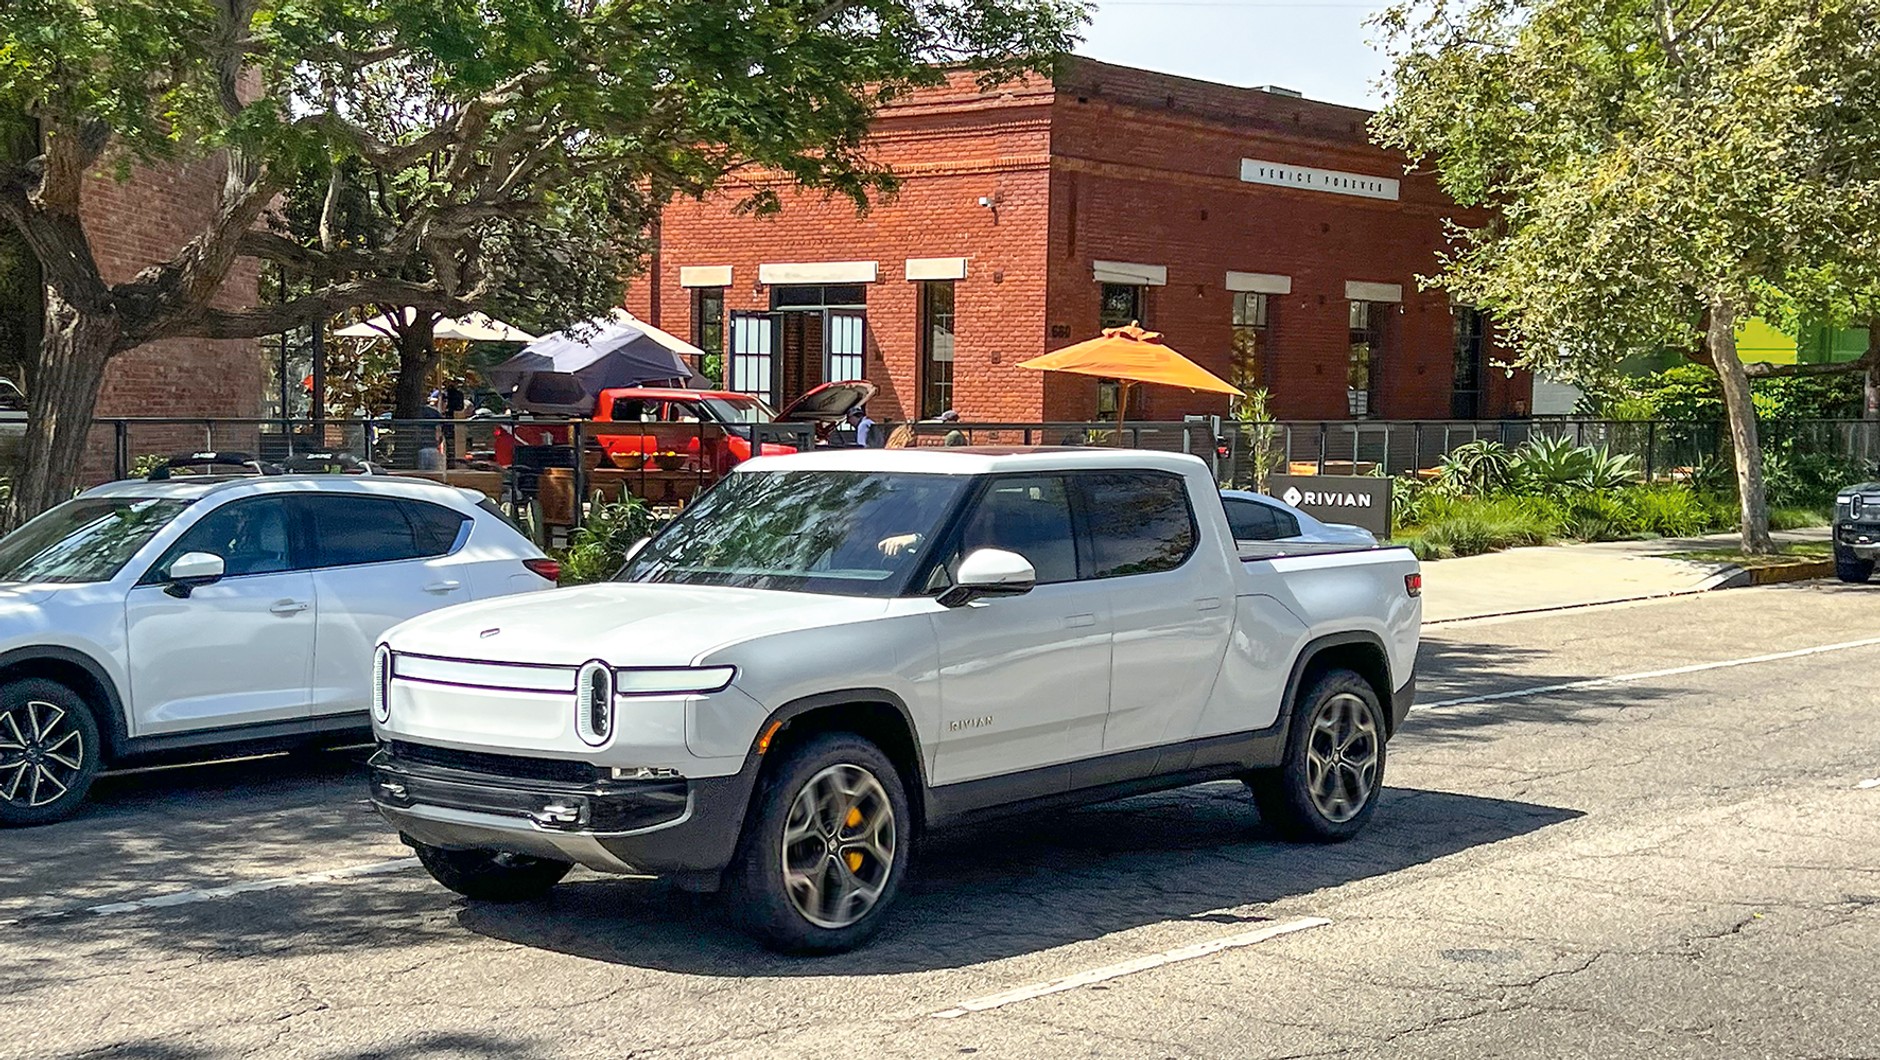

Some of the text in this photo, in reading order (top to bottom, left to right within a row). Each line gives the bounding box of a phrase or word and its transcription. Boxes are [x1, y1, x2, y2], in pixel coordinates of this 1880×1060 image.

[1260, 168, 1382, 193] VENICE FOREVER
[1304, 491, 1371, 507] RIVIAN
[949, 716, 993, 731] RIVIAN
